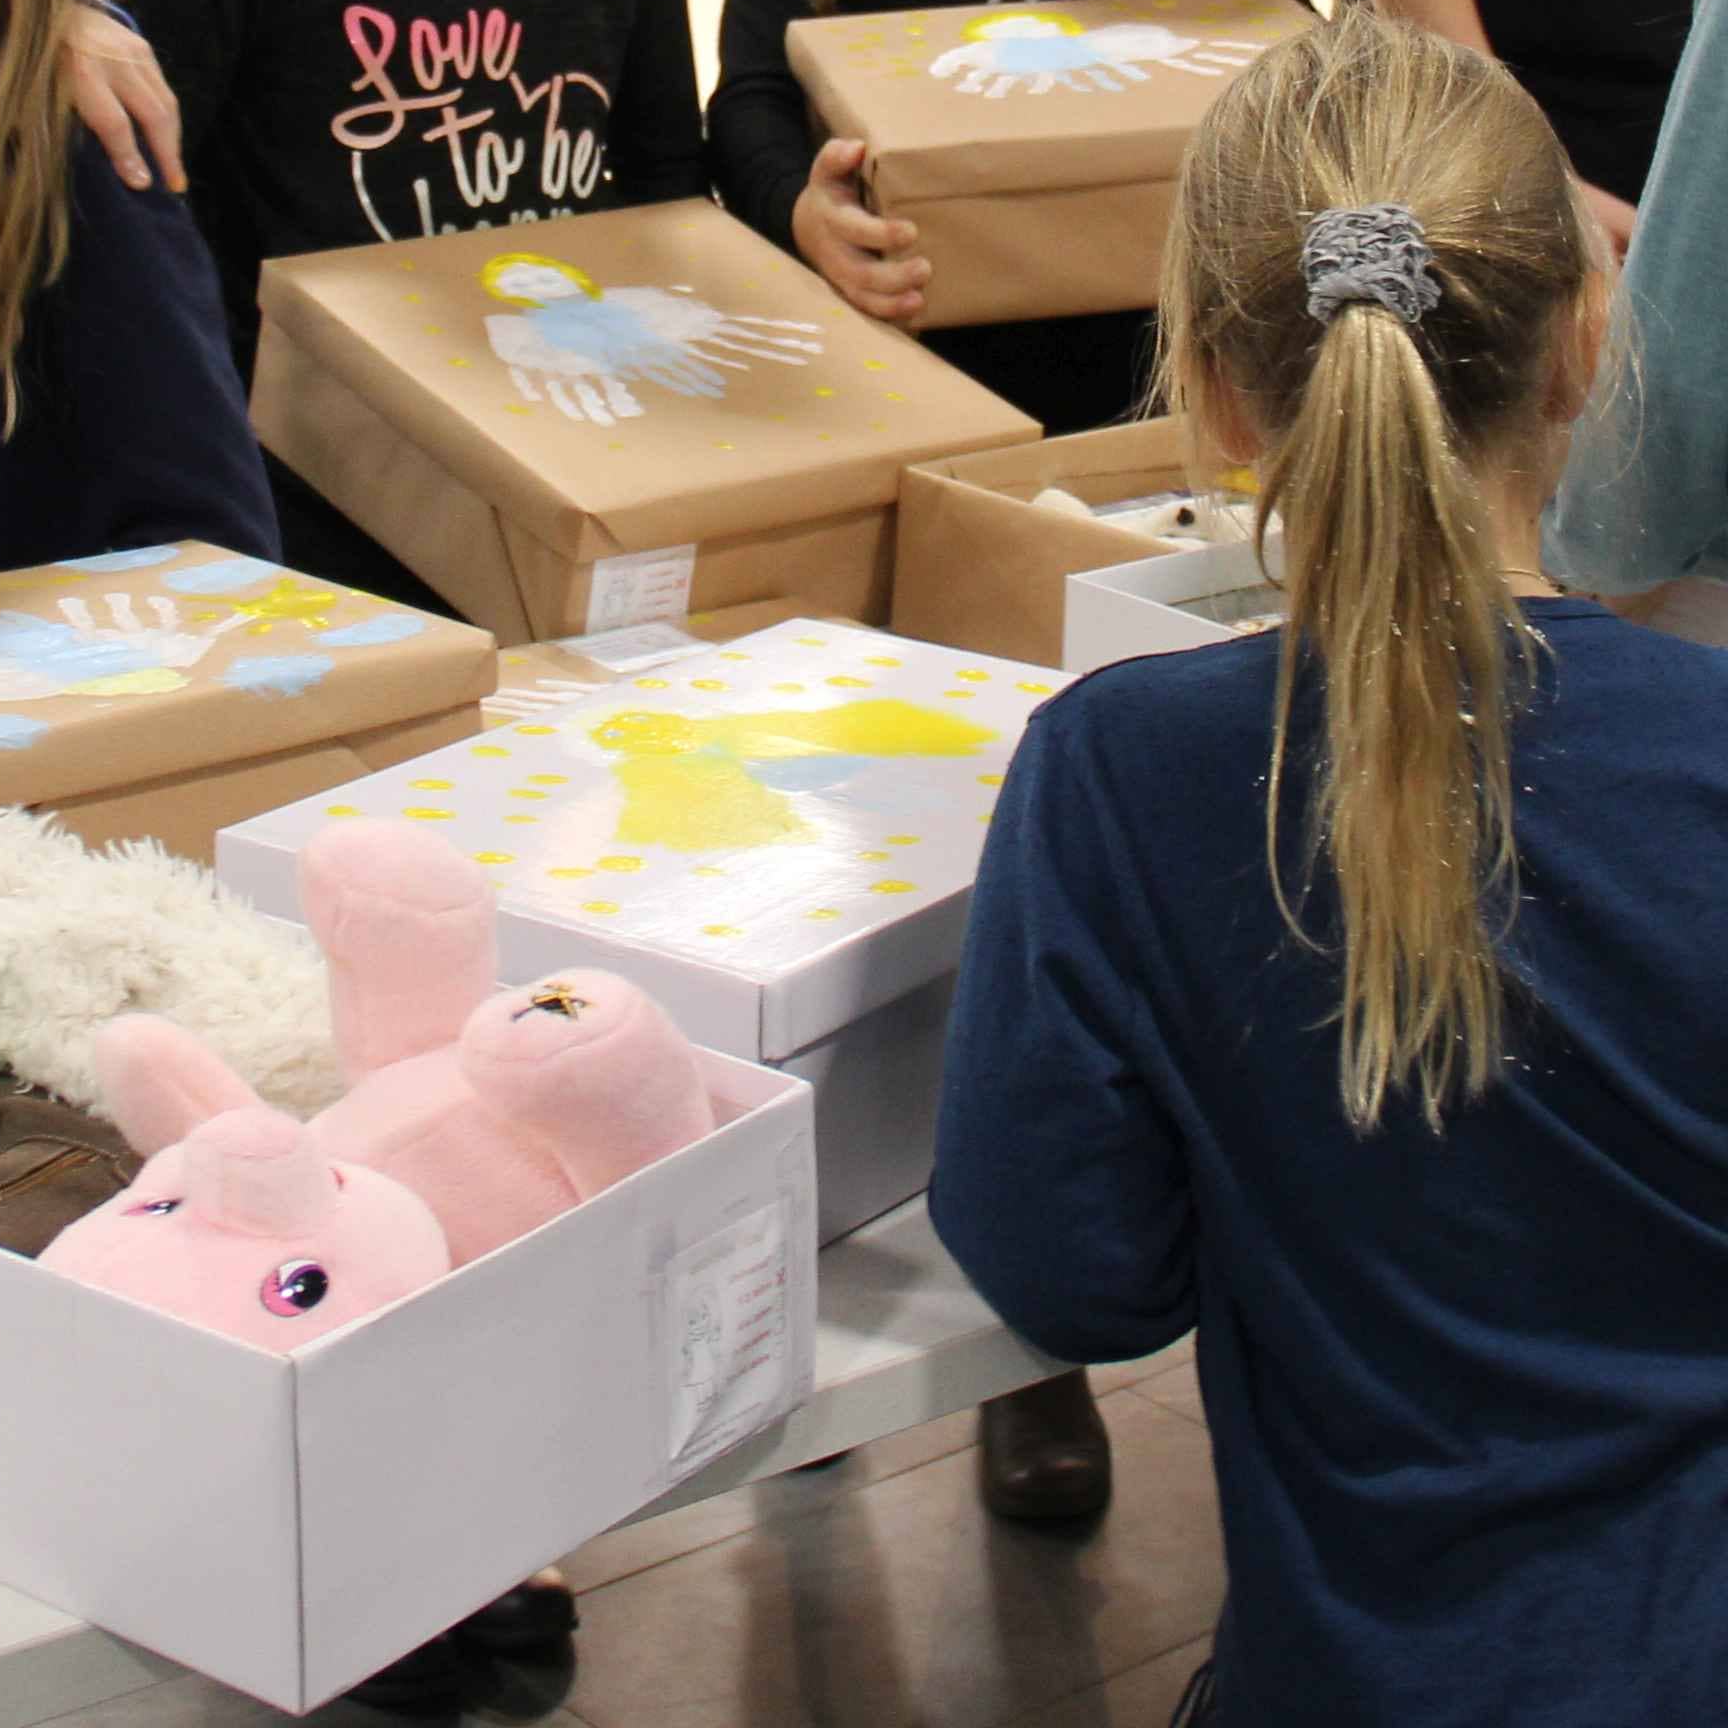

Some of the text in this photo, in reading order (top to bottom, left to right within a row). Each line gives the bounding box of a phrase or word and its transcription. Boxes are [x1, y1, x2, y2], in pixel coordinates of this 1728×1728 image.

[332, 3, 523, 149] Love
[423, 106, 524, 208] to
[540, 76, 604, 201] be
